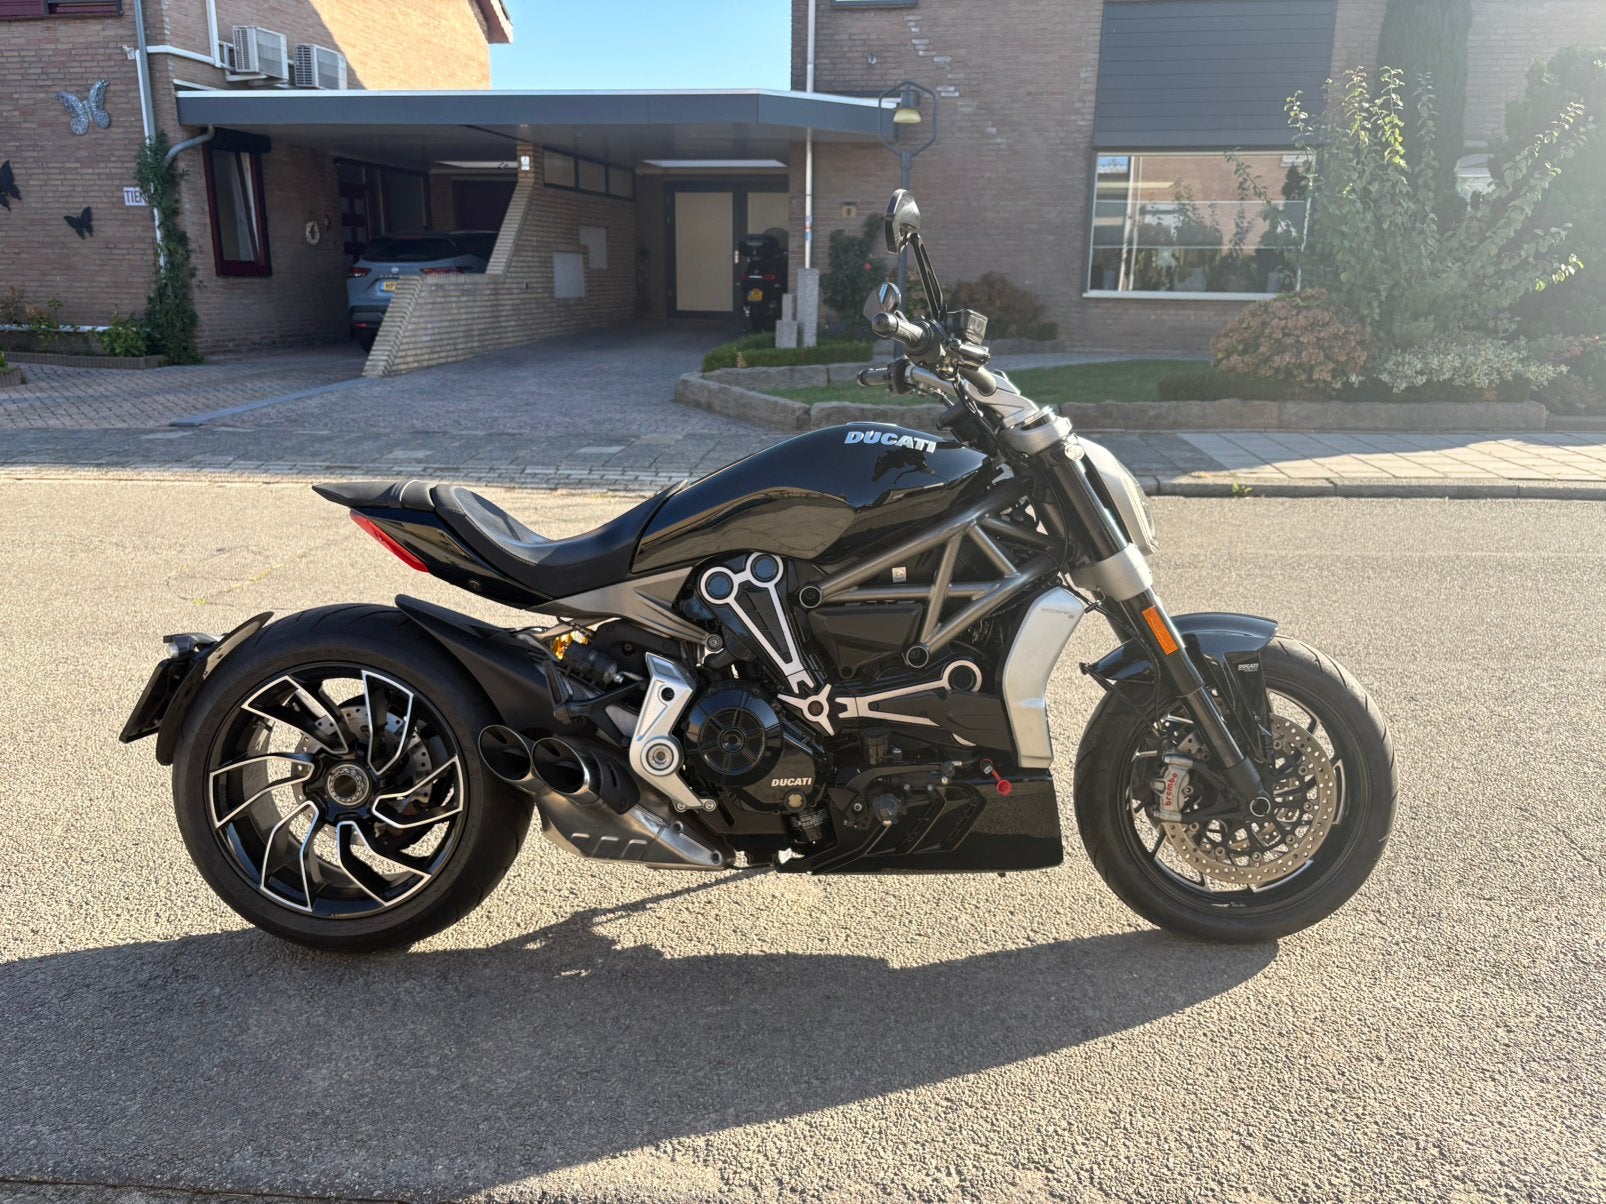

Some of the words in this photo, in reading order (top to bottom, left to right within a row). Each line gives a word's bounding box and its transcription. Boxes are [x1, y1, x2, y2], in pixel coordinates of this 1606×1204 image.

[844, 430, 937, 454] DUCATI
[771, 777, 812, 787] DUCATI
[1164, 772, 1178, 806] brembo
